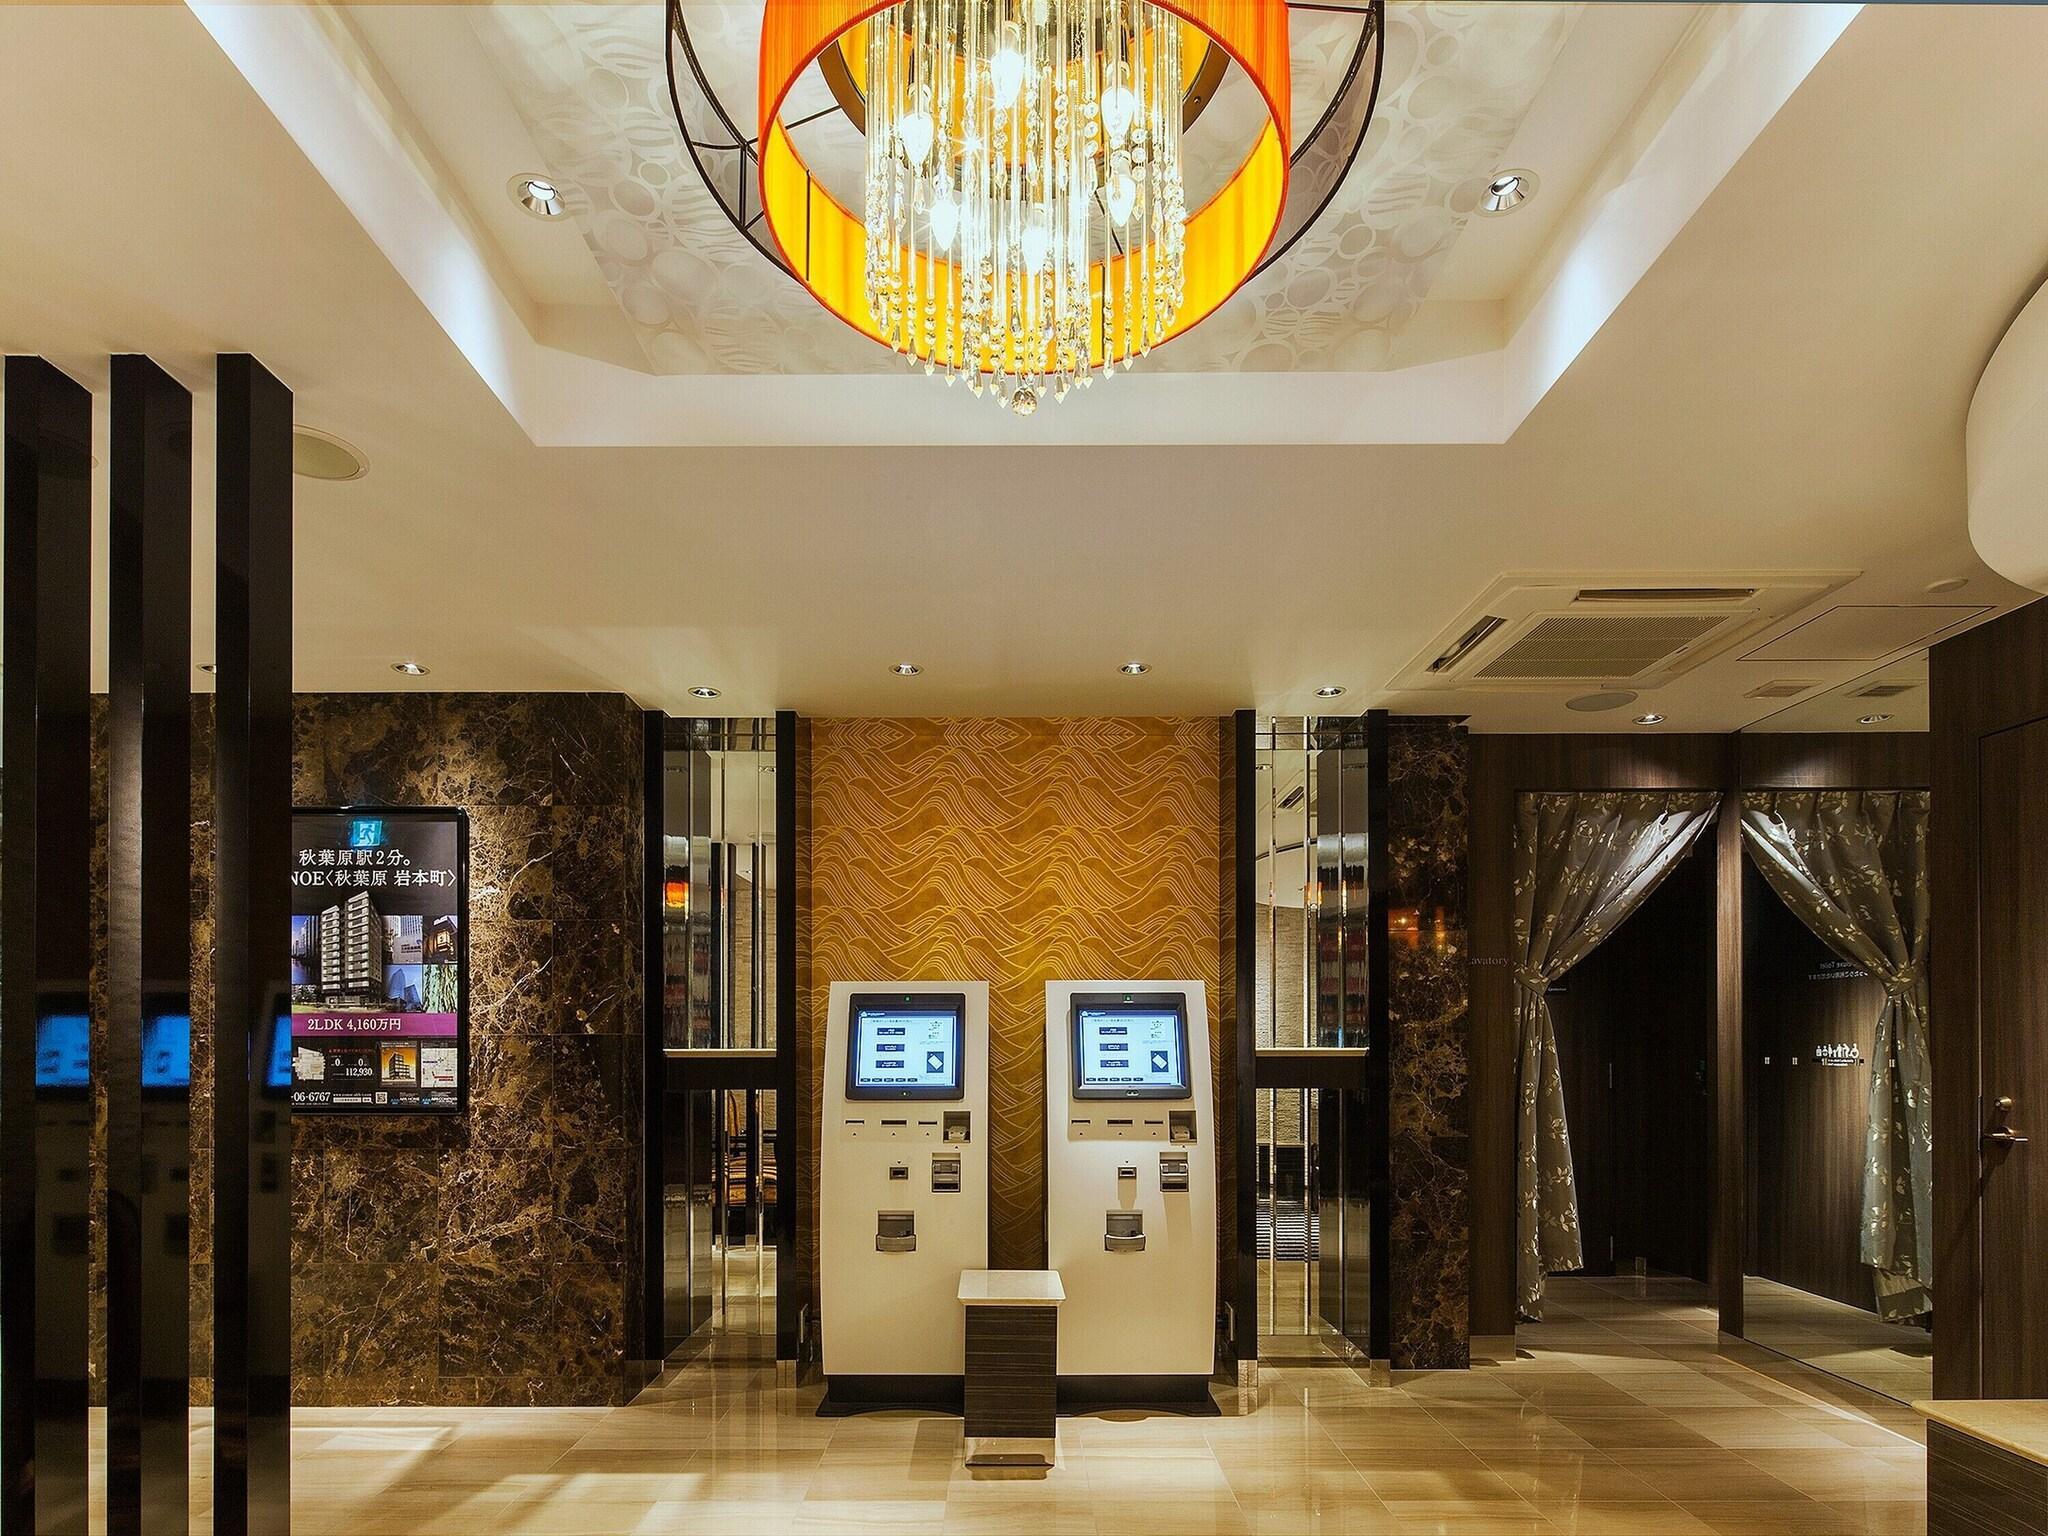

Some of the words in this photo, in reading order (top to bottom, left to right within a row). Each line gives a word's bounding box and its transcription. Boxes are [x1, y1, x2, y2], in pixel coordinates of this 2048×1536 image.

[299, 849, 411, 867] 秋葉原駅2分。
[307, 1018, 343, 1031] 2LDK
[346, 1018, 402, 1032] 4,160万円
[345, 1067, 373, 1078] 112,930
